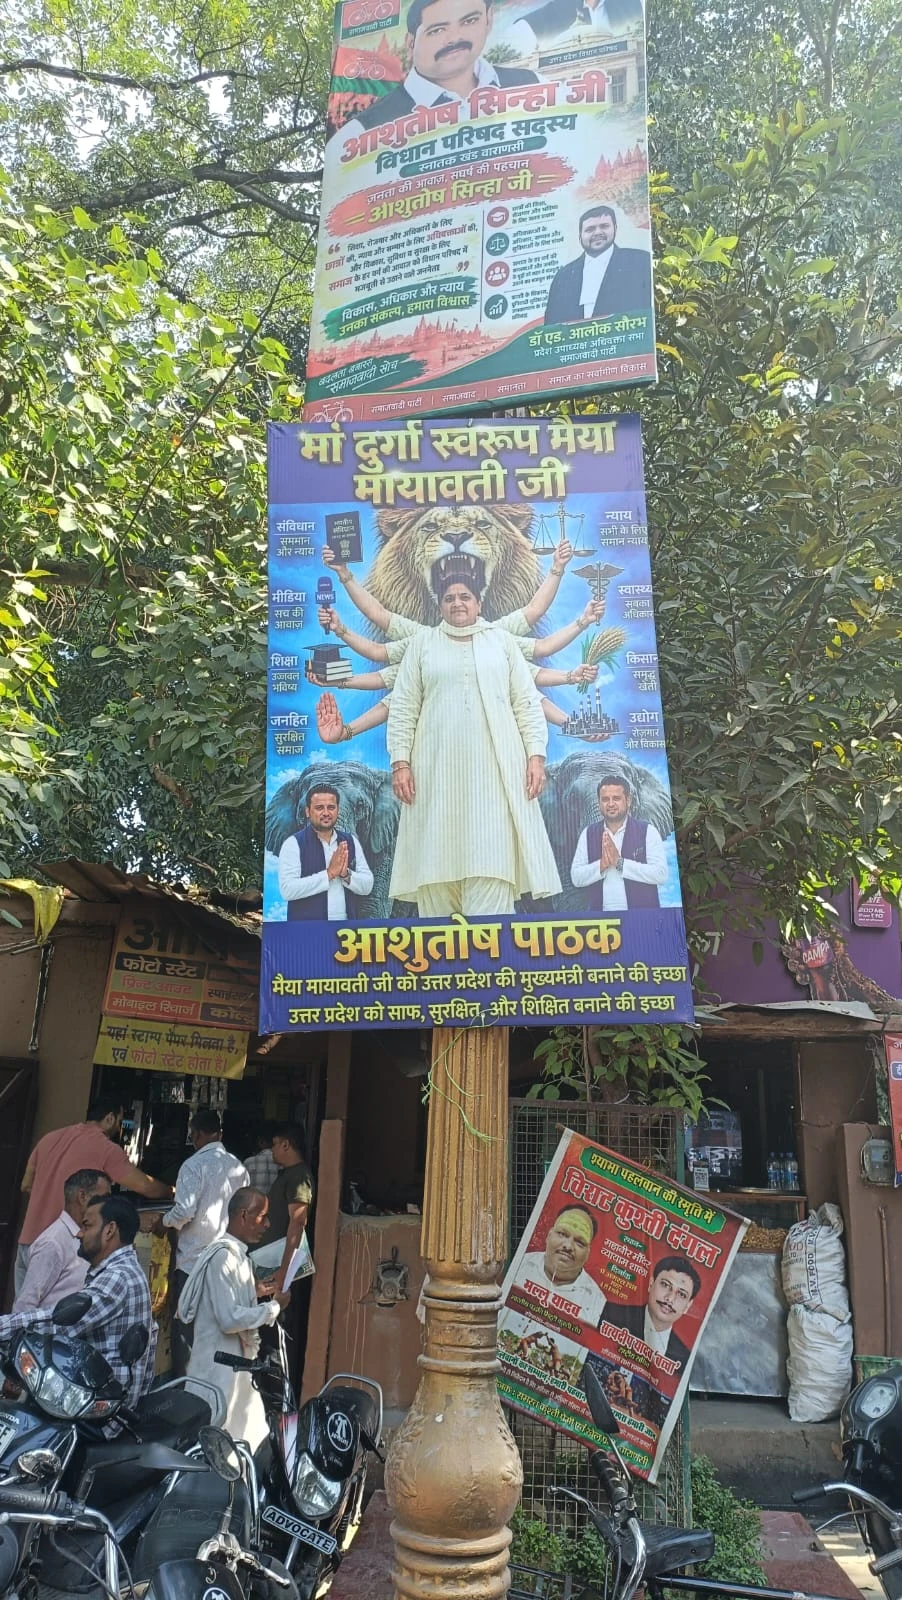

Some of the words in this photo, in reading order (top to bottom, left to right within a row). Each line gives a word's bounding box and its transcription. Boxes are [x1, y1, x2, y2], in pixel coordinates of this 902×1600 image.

[342, 96, 461, 162] आशुतोष
[469, 81, 559, 120] सिन्हा
[566, 71, 611, 104] जी
[375, 139, 437, 174] विधान
[442, 122, 505, 151] परिषद
[512, 113, 577, 136] सदस्य
[418, 157, 456, 172] स्नातक
[459, 151, 478, 162] खंड
[481, 141, 525, 157] वाराणसी
[398, 180, 413, 193] की
[450, 165, 474, 179] संघर्ष
[476, 163, 490, 175] की
[493, 159, 529, 171] पहचान
[368, 186, 447, 224] आशुतोष
[451, 177, 503, 202] सिन्हा
[507, 169, 533, 191] जी
[328, 277, 353, 291] समाज
[341, 301, 377, 323] विकास,
[379, 290, 417, 310] अधिकार
[419, 284, 438, 299] और
[440, 281, 465, 295] न्याय
[338, 319, 367, 337] उनका
[406, 299, 435, 315] हमारा
[436, 292, 471, 311] विश्वास
[528, 330, 543, 347] डॉ
[544, 331, 566, 345] एड.
[569, 321, 612, 340] आलोक
[614, 316, 648, 332] सौरभ
[533, 347, 553, 358] प्रदेश
[554, 341, 587, 354] उपाध्यक्ष
[589, 335, 626, 348] अधिवक्ता
[628, 332, 645, 342] सभा
[559, 348, 598, 364] समाजवादी
[600, 345, 617, 356] पार्टी
[300, 421, 347, 464] मां
[353, 419, 425, 474] दुर्गा
[430, 424, 540, 460] स्वरूप
[548, 416, 617, 455] मैया
[353, 458, 508, 506] मायावती
[514, 456, 569, 499] जी
[275, 519, 315, 532] संविधान
[604, 510, 633, 521] न्याय
[600, 524, 618, 536] सभी
[619, 524, 629, 535] के
[276, 545, 294, 557] और
[294, 547, 315, 556] न्याय
[600, 538, 625, 547] समान
[271, 589, 307, 603] मीडिया
[316, 592, 335, 601] NEWS
[617, 584, 653, 595] स्वास्थ्य
[274, 609, 290, 618] सच
[292, 606, 304, 618] की
[270, 652, 299, 668] शिक्षा
[625, 651, 658, 665] किसान
[272, 682, 298, 693] भविष्य
[638, 680, 657, 692] खेती
[270, 711, 309, 727] जनहित
[628, 708, 659, 723] उद्योग
[274, 730, 305, 745] सुरक्षित
[276, 745, 304, 755] समाज
[334, 912, 502, 974] आशुतोष
[511, 918, 622, 958] पाठक
[802, 940, 830, 964] CAMPA
[122, 955, 162, 974] फोटो
[165, 960, 197, 978] स्टेट
[272, 973, 302, 996] मैया
[306, 971, 371, 996] मायावती
[372, 971, 394, 995] जी
[396, 971, 419, 994] को
[422, 973, 453, 992] उत्तर
[456, 970, 493, 990] प्रदेश
[494, 968, 517, 989] की
[520, 963, 584, 991] मुख्यमंत्री
[587, 963, 625, 985] बनाने
[628, 962, 650, 984] की
[652, 964, 687, 984] इच्छा
[111, 994, 157, 1012] मोबाइल
[159, 999, 195, 1016] रिचार्ज
[288, 1006, 321, 1025] उत्तर
[324, 1003, 361, 1024] प्रदेश
[363, 1001, 384, 1022] को
[388, 1003, 426, 1023] साफ,
[490, 994, 518, 1018] और
[520, 994, 570, 1017] शिक्षित
[573, 993, 612, 1014] बनाने
[615, 992, 638, 1013] की
[640, 994, 676, 1013] इच्छा
[107, 1024, 129, 1041] यहां
[131, 1028, 162, 1045] स्टाम्प
[190, 1031, 224, 1051] मिलता
[227, 1034, 239, 1056] है,
[111, 1045, 129, 1063] एवं
[130, 1045, 158, 1065] फोटो
[161, 1050, 184, 1067] स्टेट
[187, 1052, 212, 1071] होता
[215, 1055, 228, 1072] है।
[590, 1153, 619, 1174] श्यामा
[620, 1167, 661, 1195] पहलवान
[662, 1188, 676, 1203] की
[676, 1196, 703, 1219] स्मृति
[703, 1210, 714, 1222] में
[562, 1168, 617, 1211] विराट
[611, 1194, 668, 1242] कुश्ती
[665, 1221, 722, 1266] दंगल
[521, 1280, 553, 1306] मल्लू
[550, 1294, 582, 1317] यादव
[266, 1510, 333, 1551] ADVOCATE
